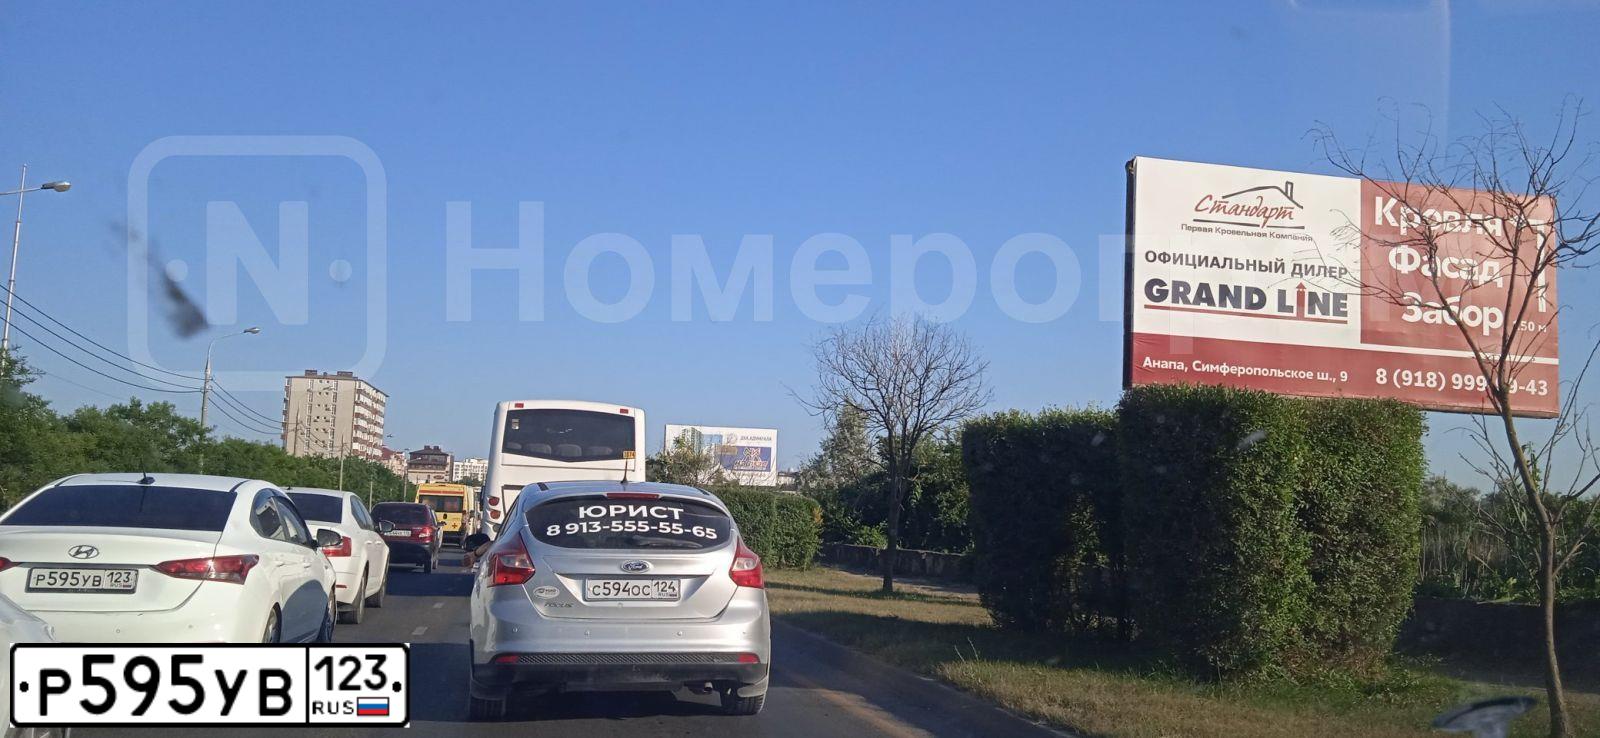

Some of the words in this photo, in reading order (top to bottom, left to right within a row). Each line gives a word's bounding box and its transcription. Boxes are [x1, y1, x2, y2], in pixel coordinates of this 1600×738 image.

[1194, 193, 1296, 229] Стандарт
[1375, 195, 1503, 236] Кровля
[1181, 223, 1213, 234] Первая
[1214, 226, 1268, 239] Кровельная
[1269, 231, 1313, 242] Компания
[1144, 249, 1286, 275] ОФИЦИАЛЬНЫЙ
[1289, 261, 1348, 280] ДИЛЕР
[1388, 244, 1503, 288] Фасад
[1144, 278, 1267, 310] GRAND
[1277, 281, 1348, 318] LINE
[1402, 291, 1503, 336] Забор
[1143, 355, 1188, 372] Анапа,
[1192, 360, 1314, 382] Симферопольское
[1317, 368, 1337, 382] ш.,
[1340, 369, 1348, 382] 9
[1375, 368, 1387, 385] 8
[1393, 368, 1446, 391] (918)
[579, 504, 684, 520] ЮРИСТ
[547, 524, 564, 537] 8
[566, 520, 718, 541] 913-555-55-65
[107, 571, 132, 584] 123
[653, 580, 676, 593] 124
